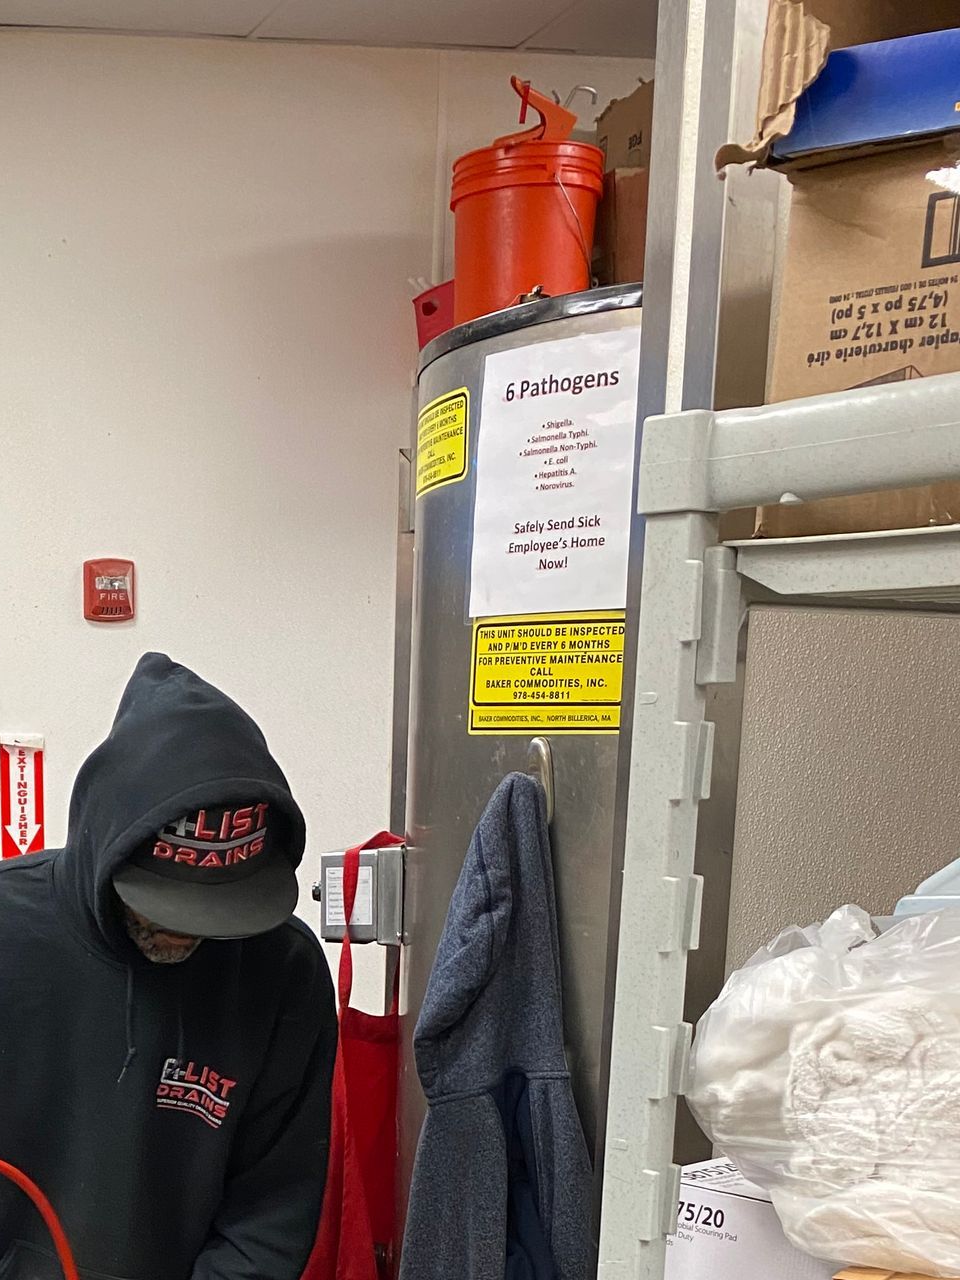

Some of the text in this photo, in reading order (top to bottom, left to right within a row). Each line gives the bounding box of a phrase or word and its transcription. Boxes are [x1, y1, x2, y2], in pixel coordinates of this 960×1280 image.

[832, 290, 948, 324] (4,75 po x 5 po)
[830, 312, 948, 341] 12 cm X 12,7 cm
[835, 338, 914, 362] charcuterie
[807, 352, 830, 368] ciré
[506, 370, 620, 402] 6 Pathogens
[439, 399, 464, 417] INSPECTED
[546, 418, 574, 430] Shigella.
[531, 429, 590, 444] Salmonella Typhi.
[523, 441, 598, 457] Salmonella Non-Typhi.
[548, 456, 569, 466] E. coli
[538, 469, 569, 480] Hepatitis
[540, 480, 574, 491] Norovirus.
[514, 514, 600, 534] Safely Send Sick
[570, 536, 606, 548] Home
[538, 556, 568, 570] Now!
[100, 592, 126, 601] FIRE
[480, 626, 625, 639] THIS UNIT SHOULD BE INSPECTED
[488, 640, 610, 652] AND P/M'D EVERY 6 MONTHS
[478, 654, 623, 666] FOR PREVENTIVE MAINTENANCE
[530, 667, 554, 676] CALL
[486, 678, 608, 690] BAKER COMMODITIES, INC.
[512, 691, 570, 700] 978-454-8811
[546, 714, 566, 722] NORTH
[567, 714, 600, 723] BILLERICA,
[600, 714, 612, 722] MA
[17, 749, 28, 846] EXTINGUISHER
[153, 836, 265, 867] DRAINS
[156, 1084, 228, 1118] DRAINS
[678, 1222, 738, 1242] obial Scouring Pad
[678, 1231, 694, 1242] Duty
